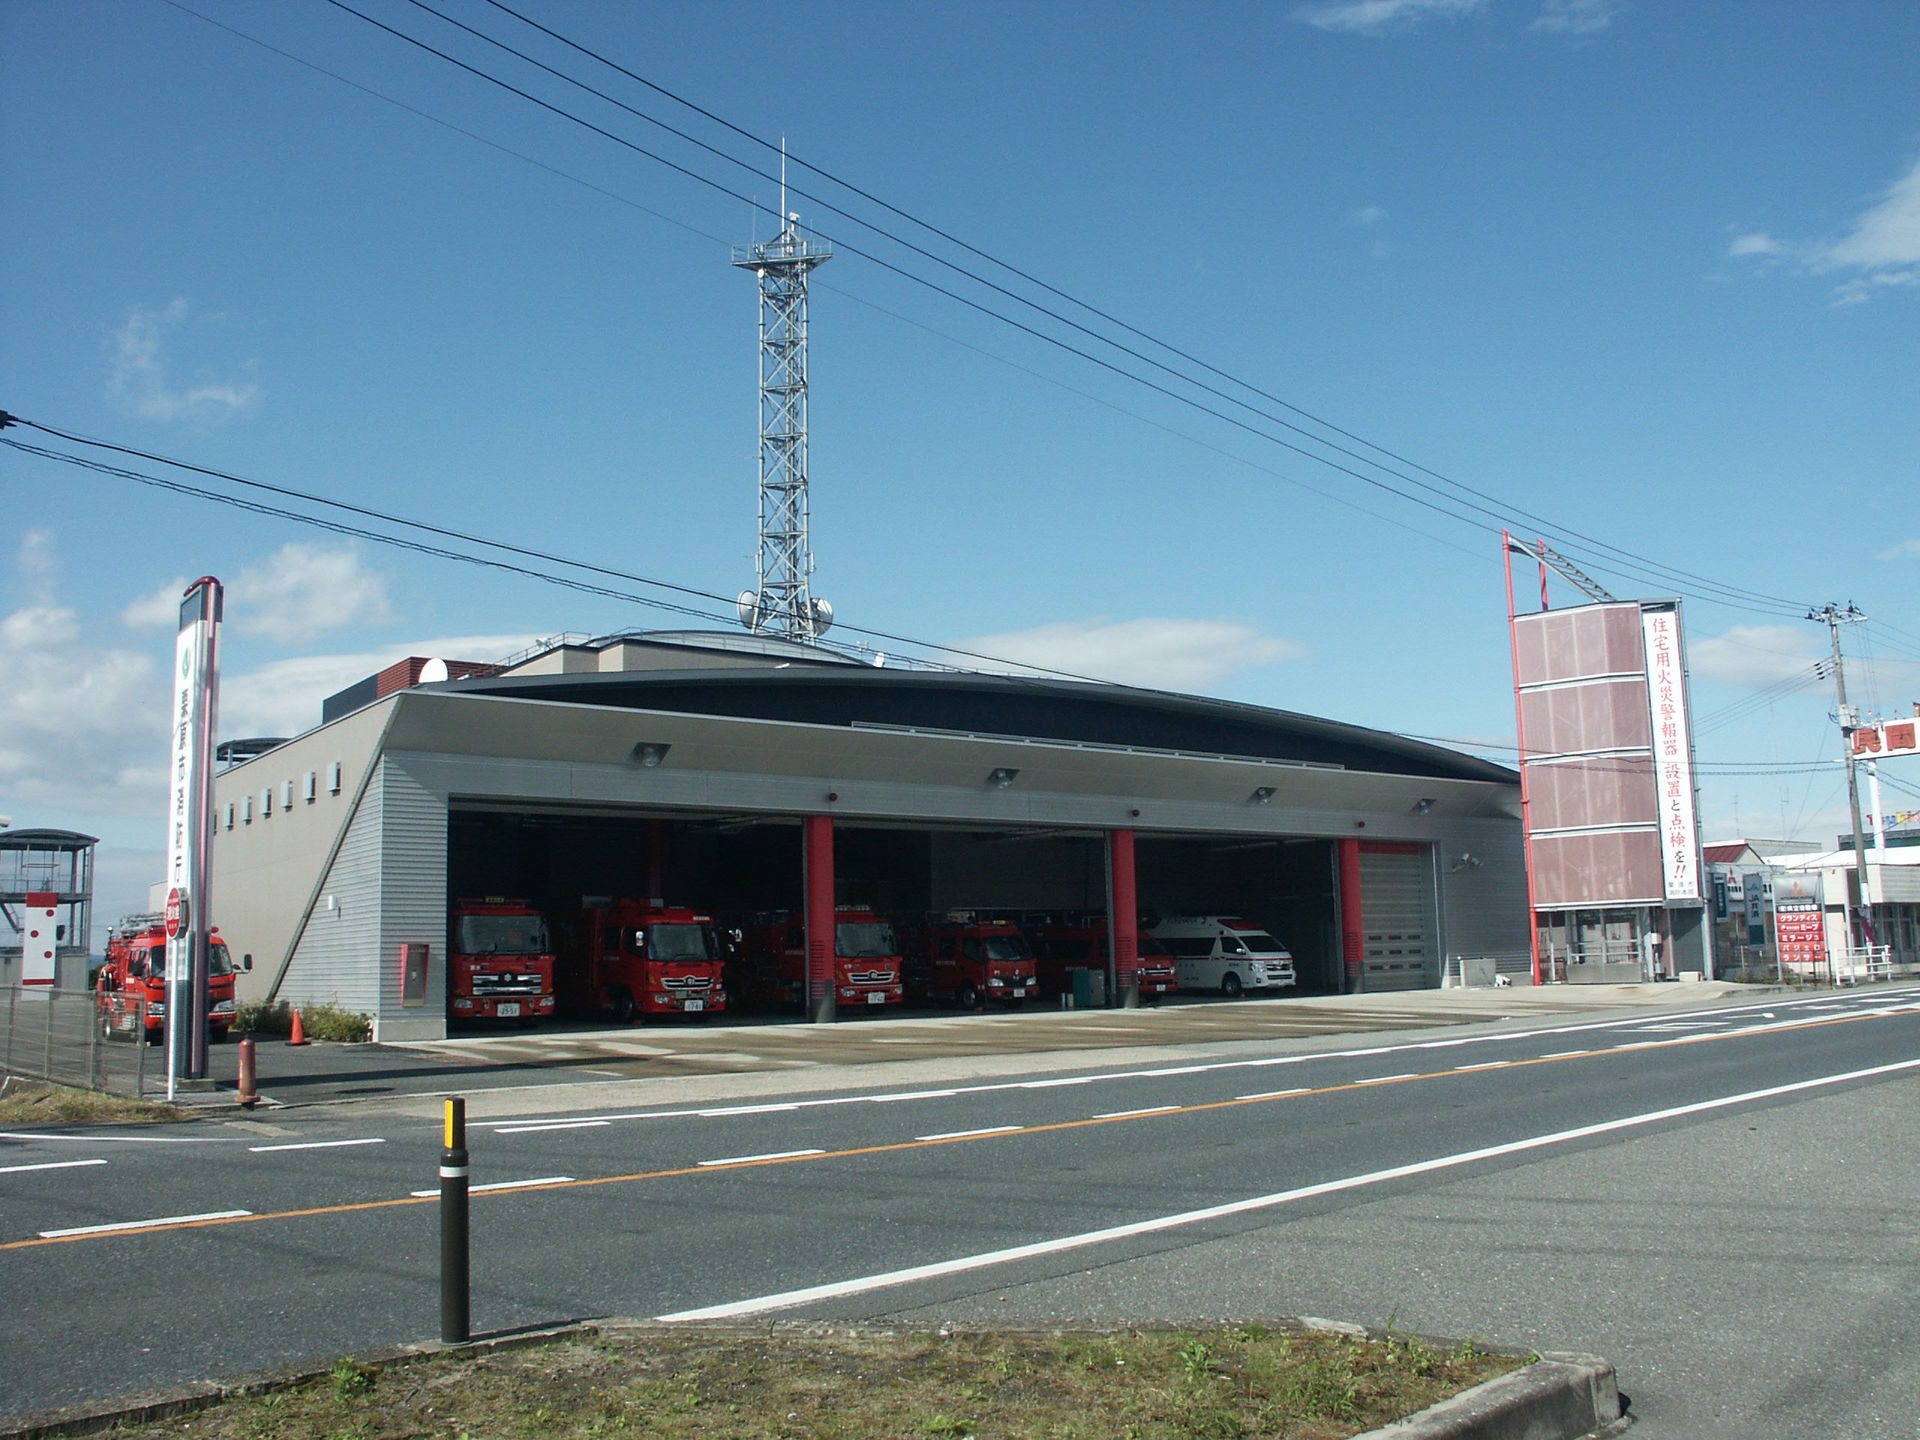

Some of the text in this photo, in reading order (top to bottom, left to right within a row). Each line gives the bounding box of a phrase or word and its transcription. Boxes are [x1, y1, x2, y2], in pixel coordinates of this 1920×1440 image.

[1653, 617, 1678, 756] 住宅用火災警報器
[1782, 934, 1820, 942] ミラージュ
